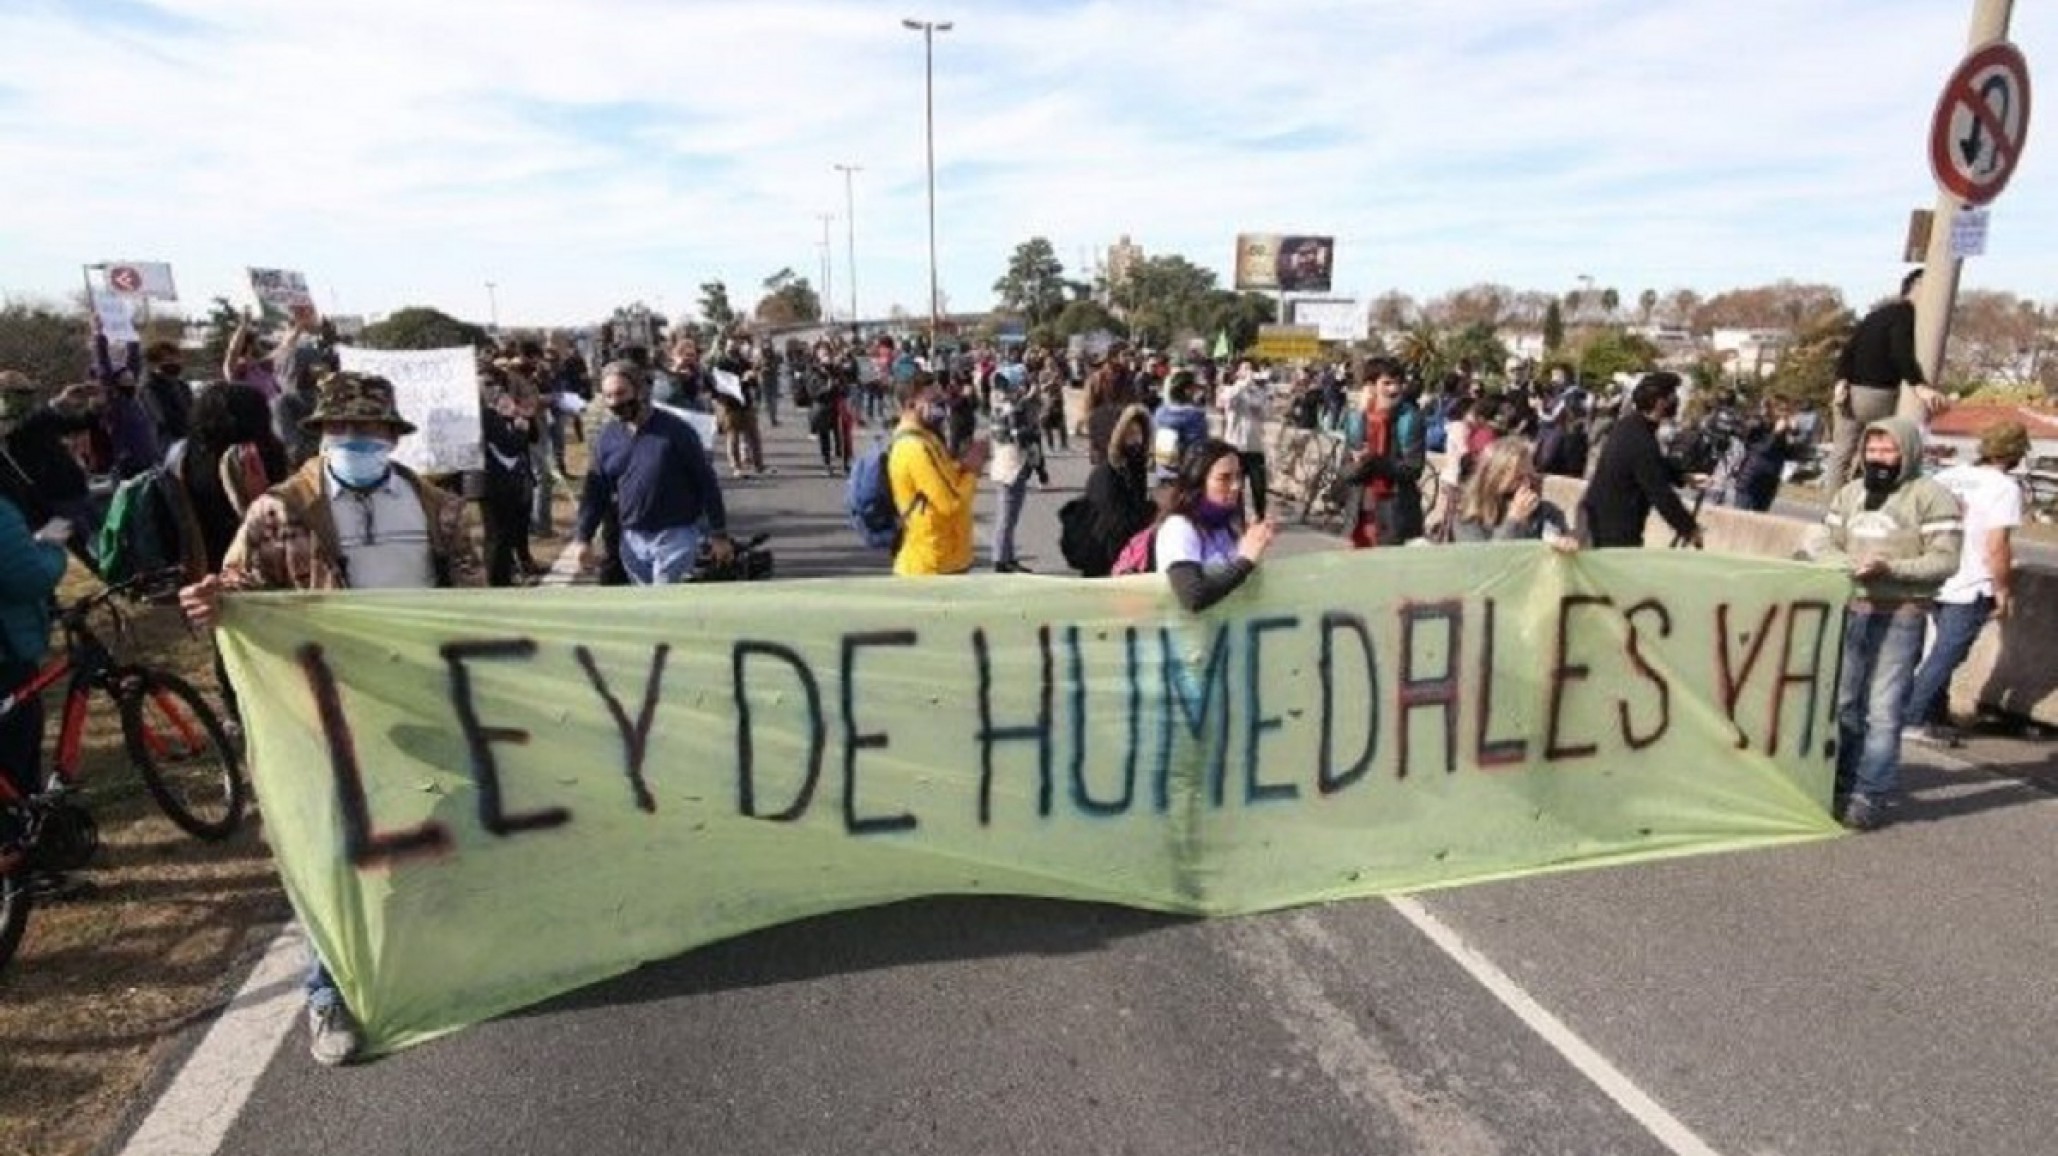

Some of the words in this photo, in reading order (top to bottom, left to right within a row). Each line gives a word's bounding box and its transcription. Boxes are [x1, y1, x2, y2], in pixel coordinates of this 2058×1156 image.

[297, 638, 669, 866] LEY
[733, 630, 916, 834] DE
[973, 596, 1671, 826] HUMEDALES
[1716, 600, 1847, 760] YA!
